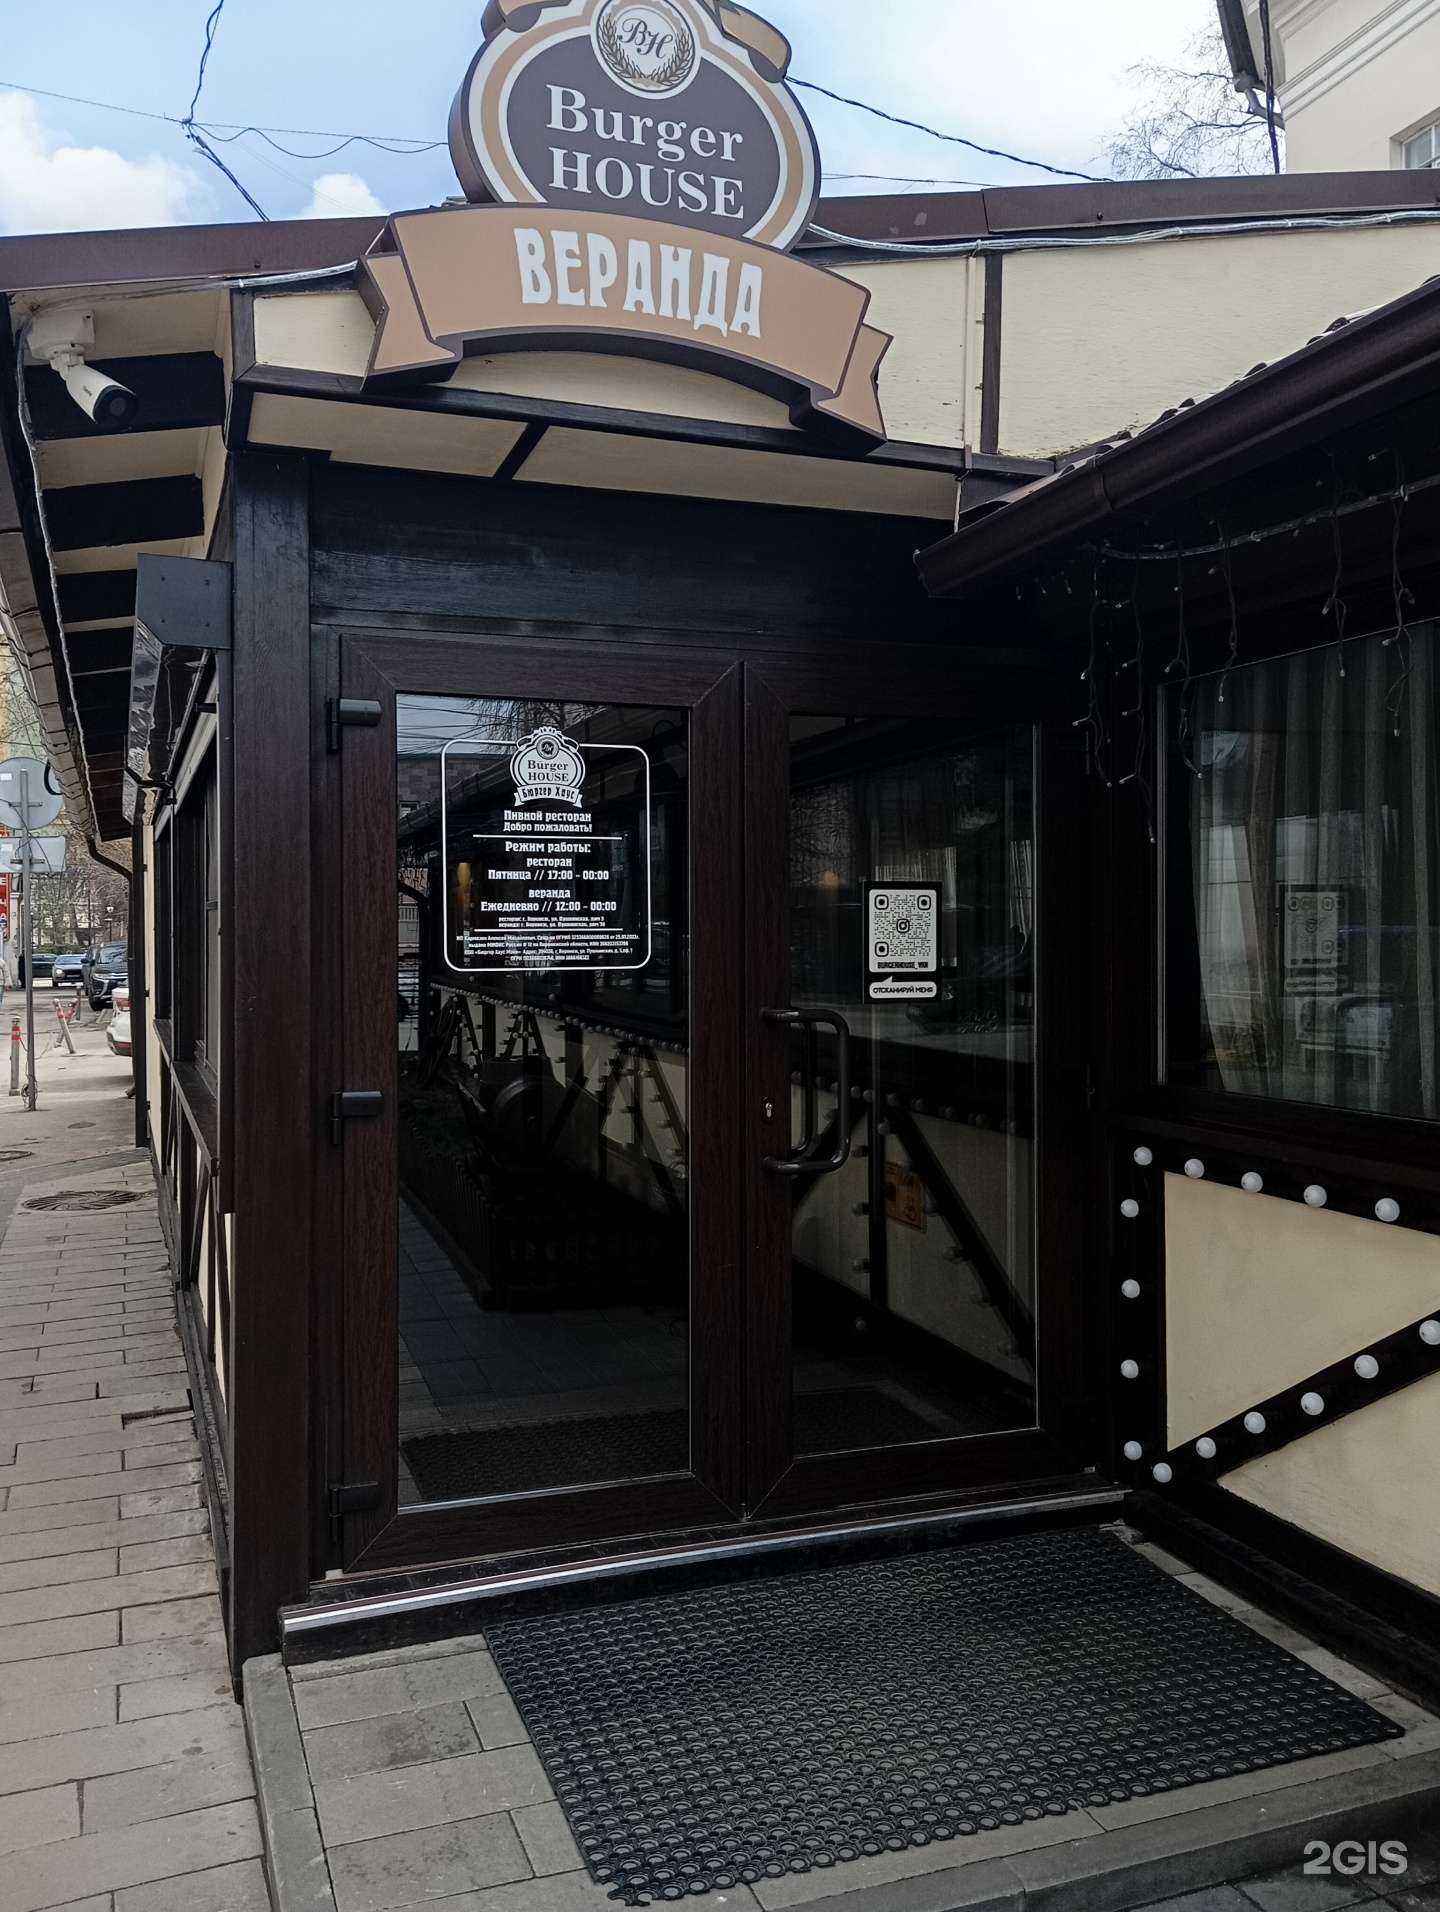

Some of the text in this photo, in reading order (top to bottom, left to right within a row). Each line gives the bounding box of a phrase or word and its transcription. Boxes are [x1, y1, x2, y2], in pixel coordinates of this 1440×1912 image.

[546, 84, 743, 162] Burger
[547, 146, 744, 220] HOUSE
[513, 227, 763, 339] ВЕРАНДА
[527, 759, 569, 772] Burger
[527, 771, 569, 782] HOUSE
[503, 810, 592, 823] Пивной ресторан
[503, 822, 593, 833] Добро пожаловать!
[505, 841, 592, 853] Режим работы:
[526, 858, 572, 868] ресторан
[488, 870, 532, 880] Пятница
[547, 870, 574, 880] 17:00
[582, 870, 610, 880] 00:00
[528, 889, 571, 899] веранда
[480, 901, 540, 912] Ежедневно
[555, 901, 581, 911] 12:00
[590, 901, 617, 911] 00:00
